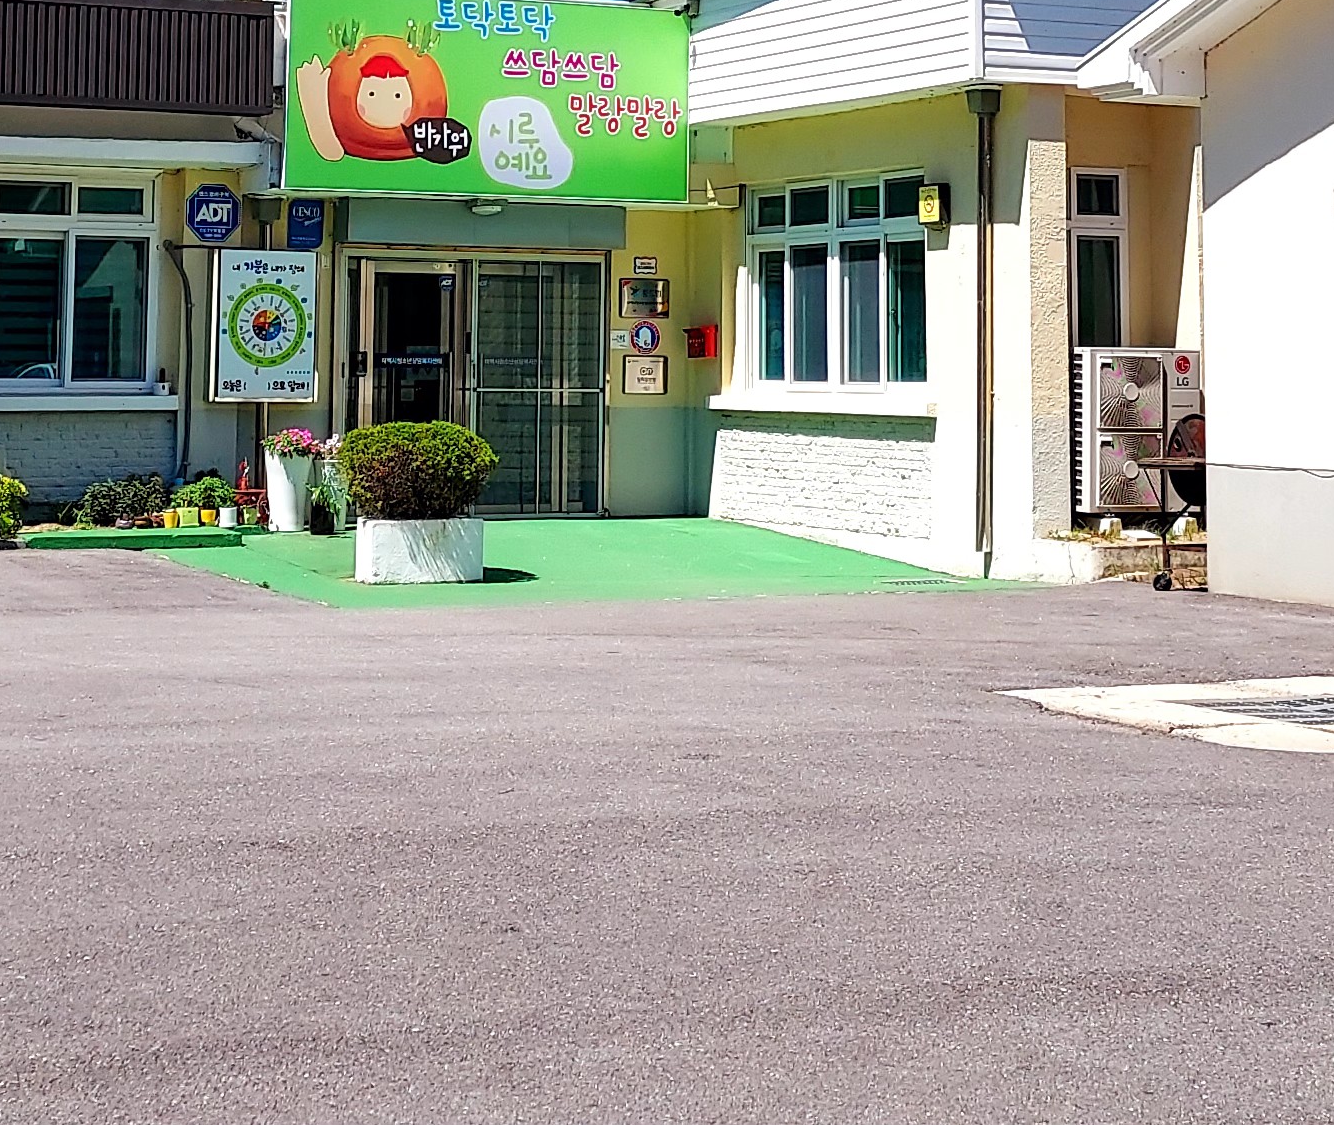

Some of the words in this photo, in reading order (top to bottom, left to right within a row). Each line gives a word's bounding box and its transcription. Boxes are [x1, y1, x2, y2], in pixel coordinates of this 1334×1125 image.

[503, 49, 621, 89] 쓰담쓰담
[489, 112, 540, 149] 시루
[569, 93, 683, 138] 말랑말랑
[413, 121, 468, 158] 반가워
[494, 147, 553, 179] 예요
[196, 203, 232, 223] ADT
[1176, 376, 1190, 387] LG
